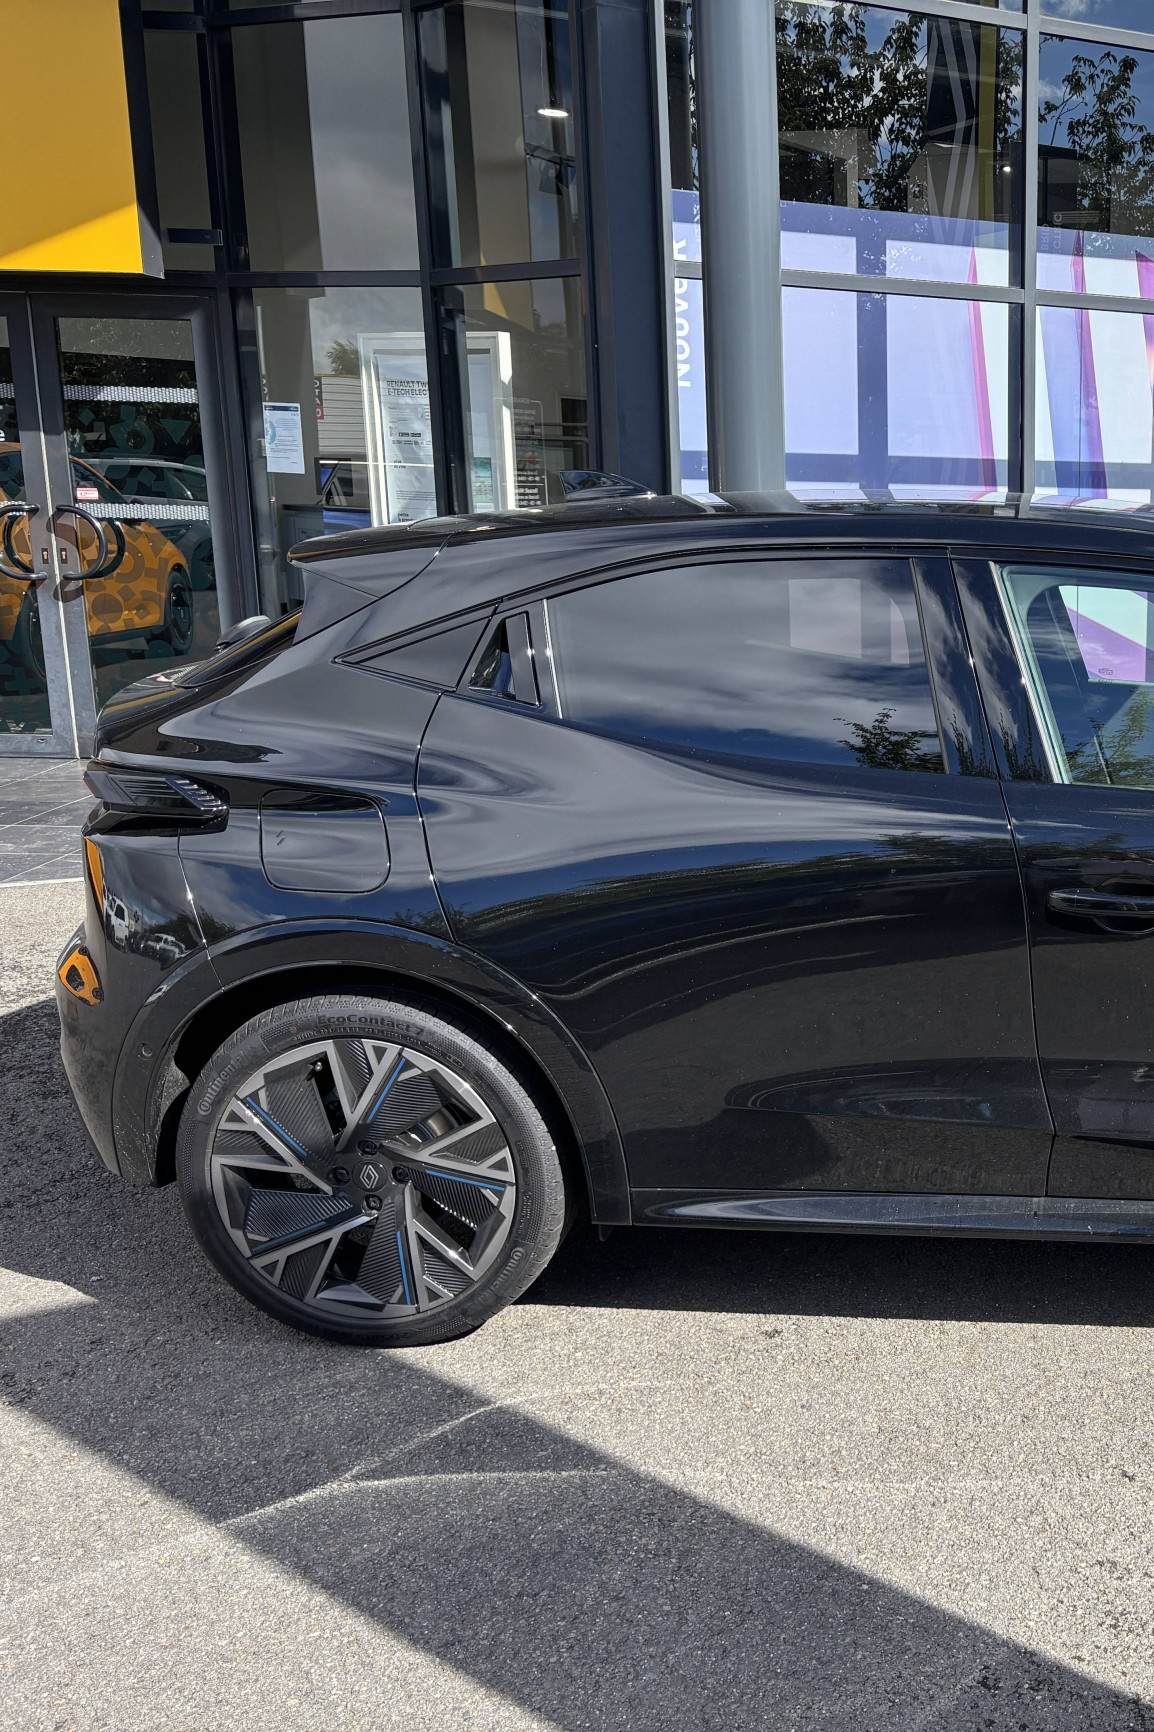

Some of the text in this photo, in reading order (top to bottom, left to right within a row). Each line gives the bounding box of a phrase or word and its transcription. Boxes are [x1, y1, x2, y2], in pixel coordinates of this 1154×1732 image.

[386, 380, 428, 388] RENAULT TW
[387, 388, 429, 396] E-TECH ELEC
[317, 1014, 413, 1035] EcoContact
[414, 1026, 424, 1037] 7
